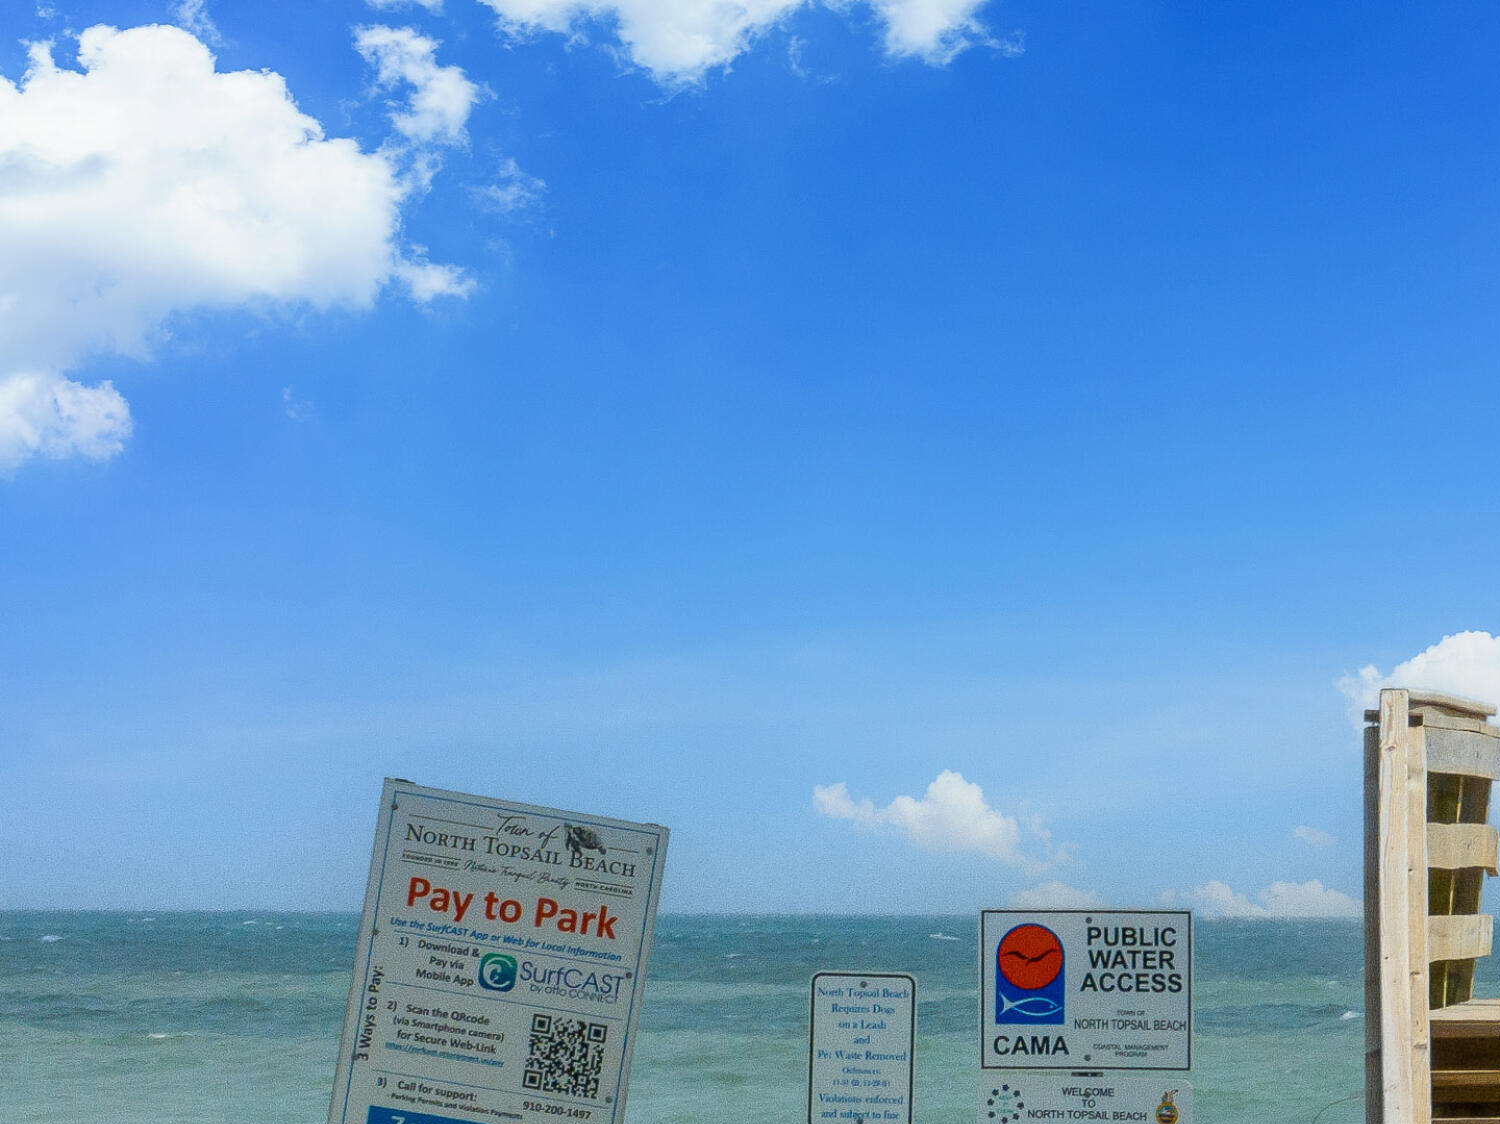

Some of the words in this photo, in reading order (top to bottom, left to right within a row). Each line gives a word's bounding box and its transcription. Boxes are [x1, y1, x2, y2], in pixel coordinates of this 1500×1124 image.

[497, 814, 534, 837] Town
[538, 825, 560, 849] of
[404, 823, 477, 851] NORTH
[483, 836, 562, 865] TOPSAIL
[569, 850, 636, 877] BEACH
[407, 876, 474, 922] Pay
[484, 891, 523, 923] to
[534, 897, 618, 940] Park
[390, 916, 407, 927] Use
[409, 920, 426, 930] the
[426, 922, 469, 937] SurfCAST
[470, 930, 489, 941] App
[503, 935, 524, 946] Web
[524, 938, 540, 949] for
[541, 942, 567, 953] Local
[567, 945, 622, 961] Information
[399, 936, 410, 948] 1)
[418, 939, 469, 956] Download
[471, 948, 480, 958] &
[1086, 927, 1177, 947] PUBLIC
[429, 956, 448, 968] Pay
[449, 960, 465, 970] via
[1089, 950, 1175, 970] WATER
[369, 965, 385, 993] Pay:
[416, 968, 451, 982] Mobile
[453, 975, 474, 987] App
[520, 961, 624, 996] SurfCAST
[1080, 973, 1183, 993] ACCESS
[817, 987, 844, 998] North
[846, 987, 880, 999] Topsail
[882, 988, 909, 999] Beach
[366, 997, 378, 1011] to
[387, 1000, 398, 1012] 2)
[406, 1004, 429, 1016] Scan
[432, 1008, 449, 1019] the
[451, 1011, 490, 1026] QRcode
[831, 1003, 870, 1015] Requires
[872, 1004, 896, 1015] Dogs
[359, 1014, 377, 1049] Ways
[393, 1015, 410, 1026] (via
[411, 1019, 466, 1036] Smartphone
[468, 1029, 505, 1042] camera)
[860, 1019, 887, 1030] Leash
[1074, 1018, 1109, 1031] NORTH
[1112, 1019, 1151, 1031] TOPSAIL
[1153, 1020, 1187, 1032] BEACH
[397, 1030, 411, 1039] for
[414, 1033, 447, 1046] Secure
[450, 1038, 497, 1055] Web-Link
[853, 1035, 871, 1045] and
[993, 1035, 1069, 1055] CAMA
[1093, 1043, 1121, 1051] COASTAL
[358, 1052, 369, 1061] 3
[835, 1050, 862, 1060] Waste
[865, 1051, 906, 1062] Removed
[397, 1080, 416, 1091] Call
[418, 1084, 433, 1094] for
[435, 1088, 477, 1102] support:
[819, 1093, 862, 1104] Violations
[865, 1095, 903, 1105] enforced
[1062, 1087, 1115, 1097] WELCOME
[523, 1101, 591, 1121] 910-200-1497
[1081, 1099, 1096, 1108] TO
[821, 1109, 837, 1118] and
[872, 1111, 881, 1119] to
[1027, 1109, 1064, 1119] NORTH
[1067, 1110, 1110, 1120] TOPSAIL
[1112, 1111, 1147, 1121] BEACH
